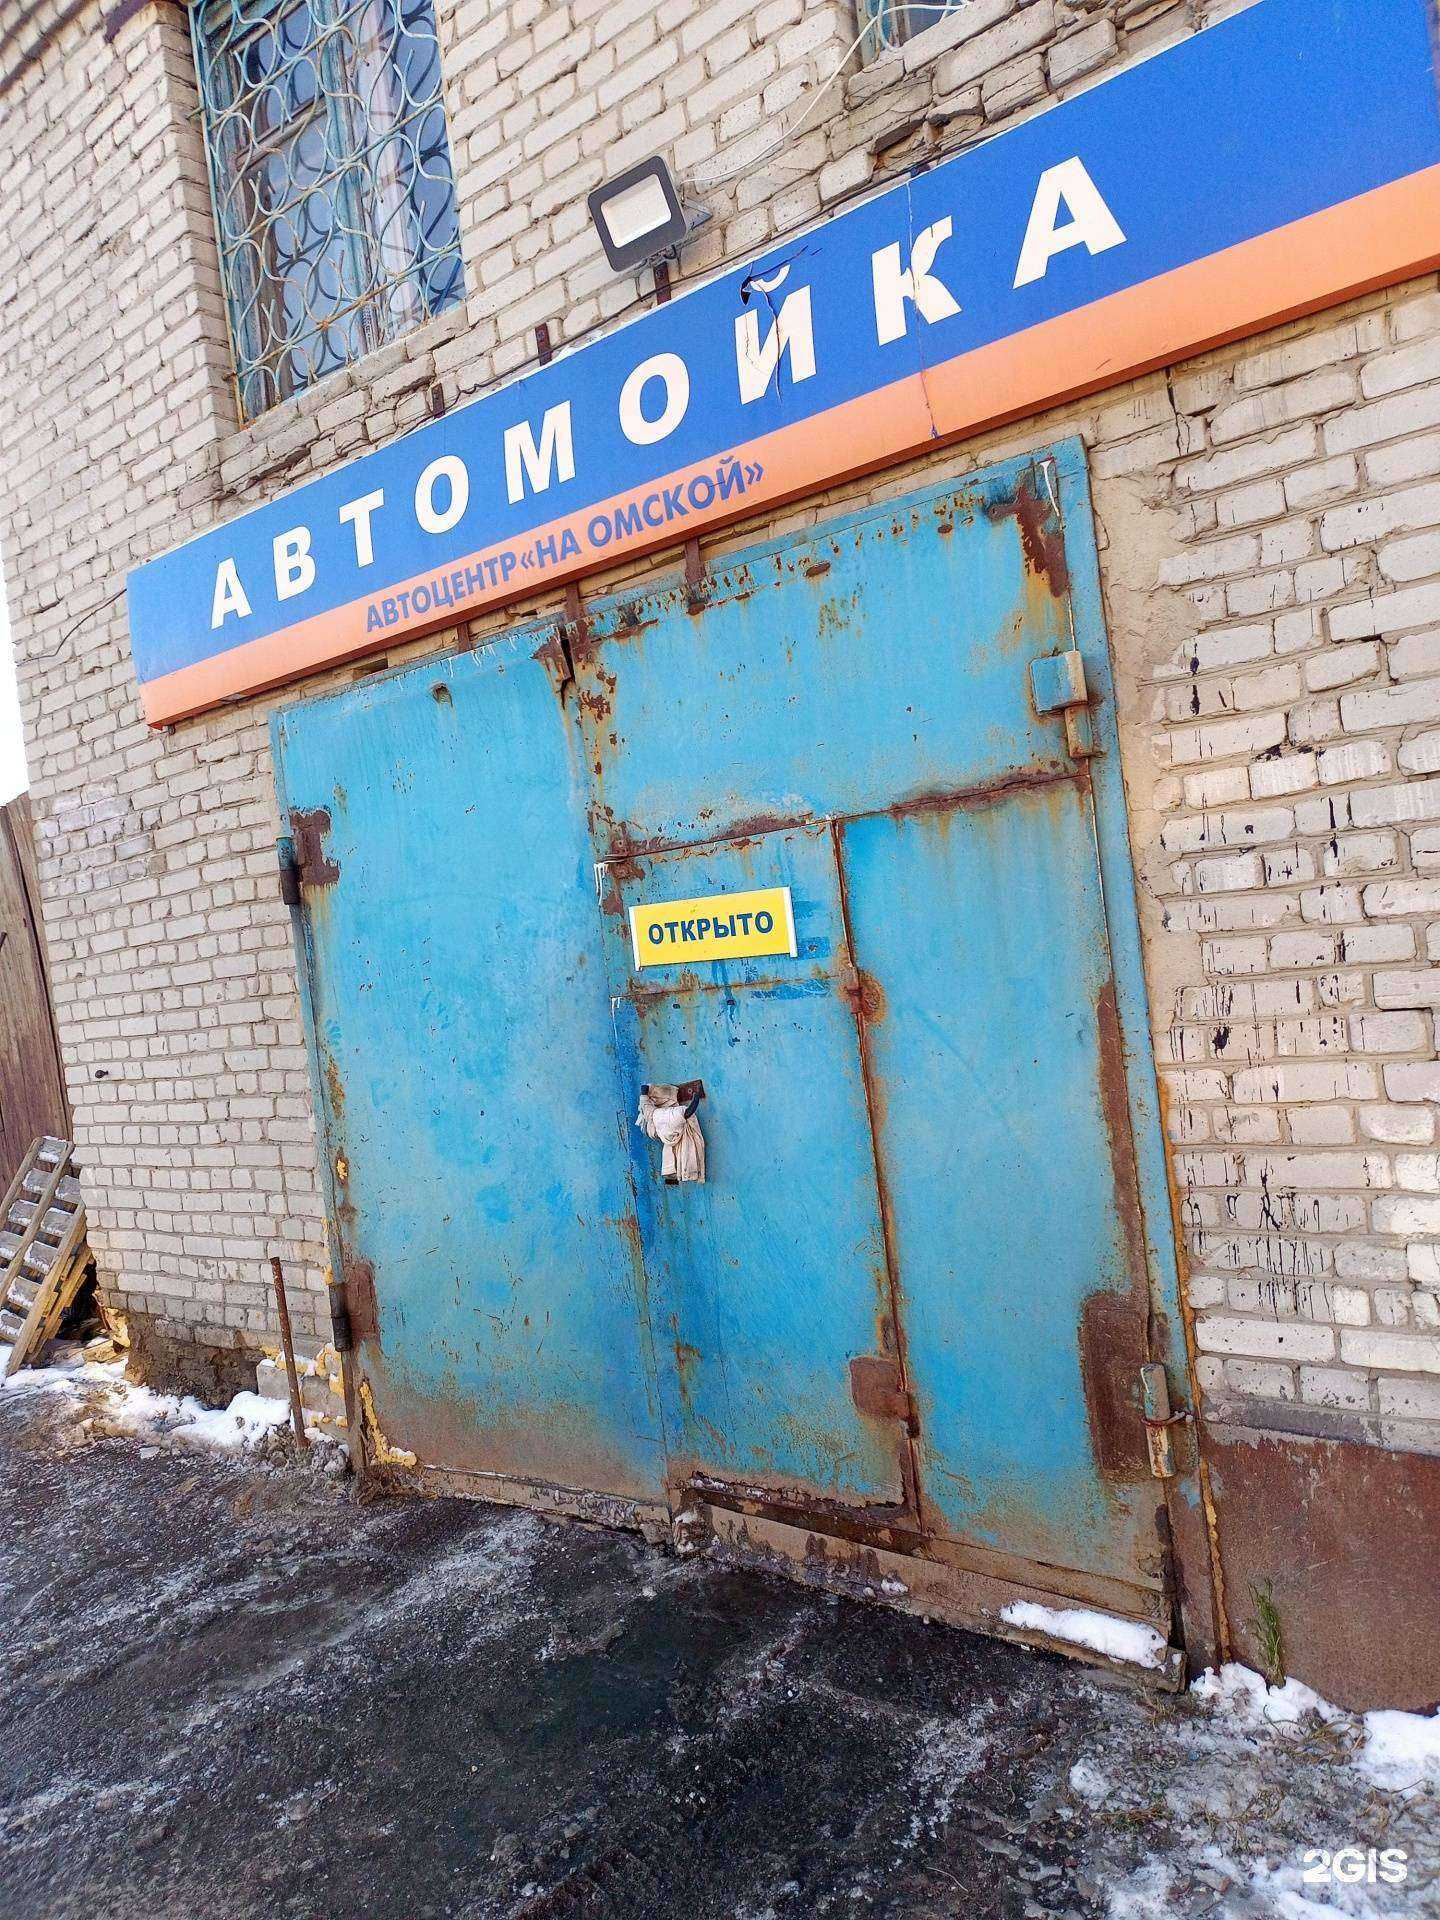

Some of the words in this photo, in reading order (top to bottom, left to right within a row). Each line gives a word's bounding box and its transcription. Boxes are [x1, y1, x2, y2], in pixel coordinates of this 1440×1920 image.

[210, 155, 1127, 629] АВТОМОЙКА
[366, 550, 517, 633] АВТОЦЕНТР
[520, 530, 583, 569] «НА
[587, 455, 764, 548] ОМСКОЙ»
[648, 910, 774, 945] ОТКРЫТО
